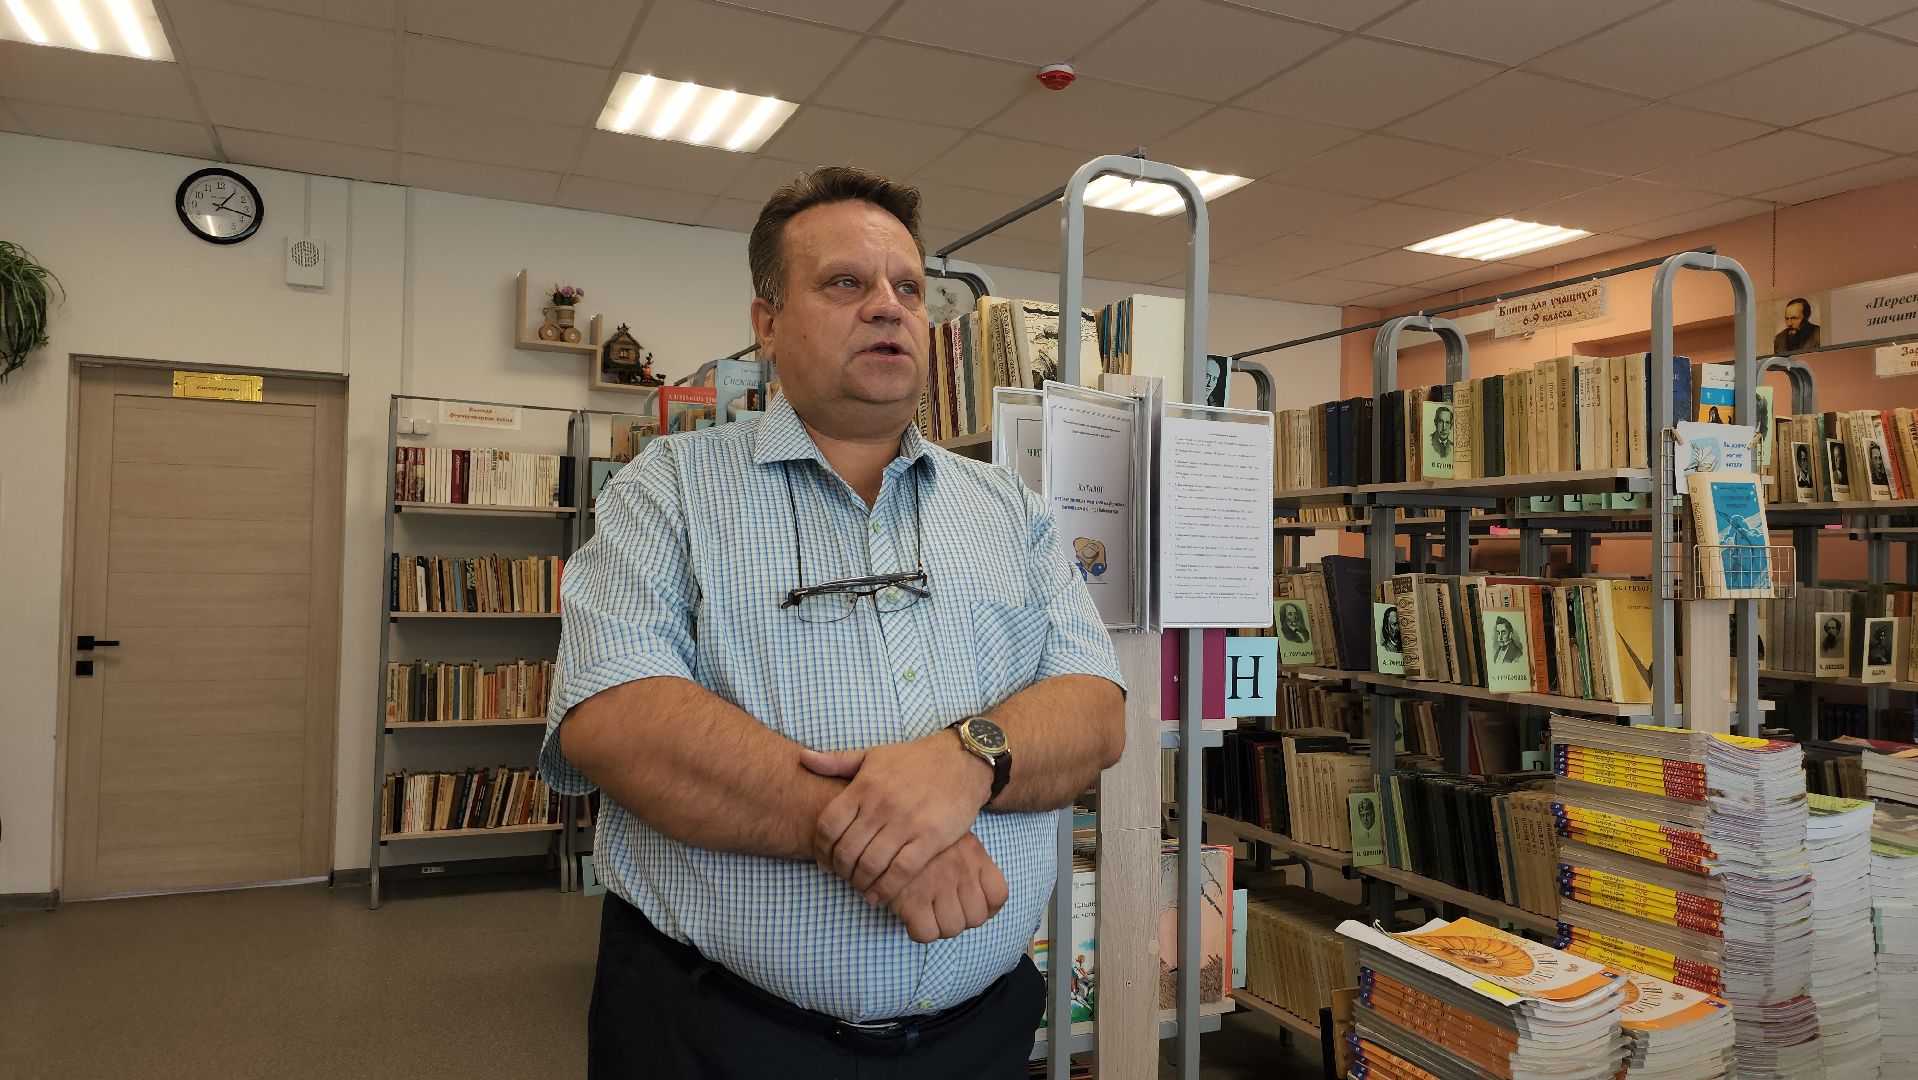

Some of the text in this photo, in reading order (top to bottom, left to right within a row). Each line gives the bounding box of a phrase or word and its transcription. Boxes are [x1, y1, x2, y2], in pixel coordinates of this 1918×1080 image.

[204, 184, 212, 192] 11
[216, 182, 226, 190] 12
[195, 191, 204, 199] 10
[240, 215, 245, 223] 4
[231, 223, 237, 231] 5
[1499, 288, 1598, 317] Книги для учащихся
[1523, 310, 1572, 325] 6-9 класса
[1867, 311, 1917, 326] значит
[1227, 655, 1264, 700] Н
